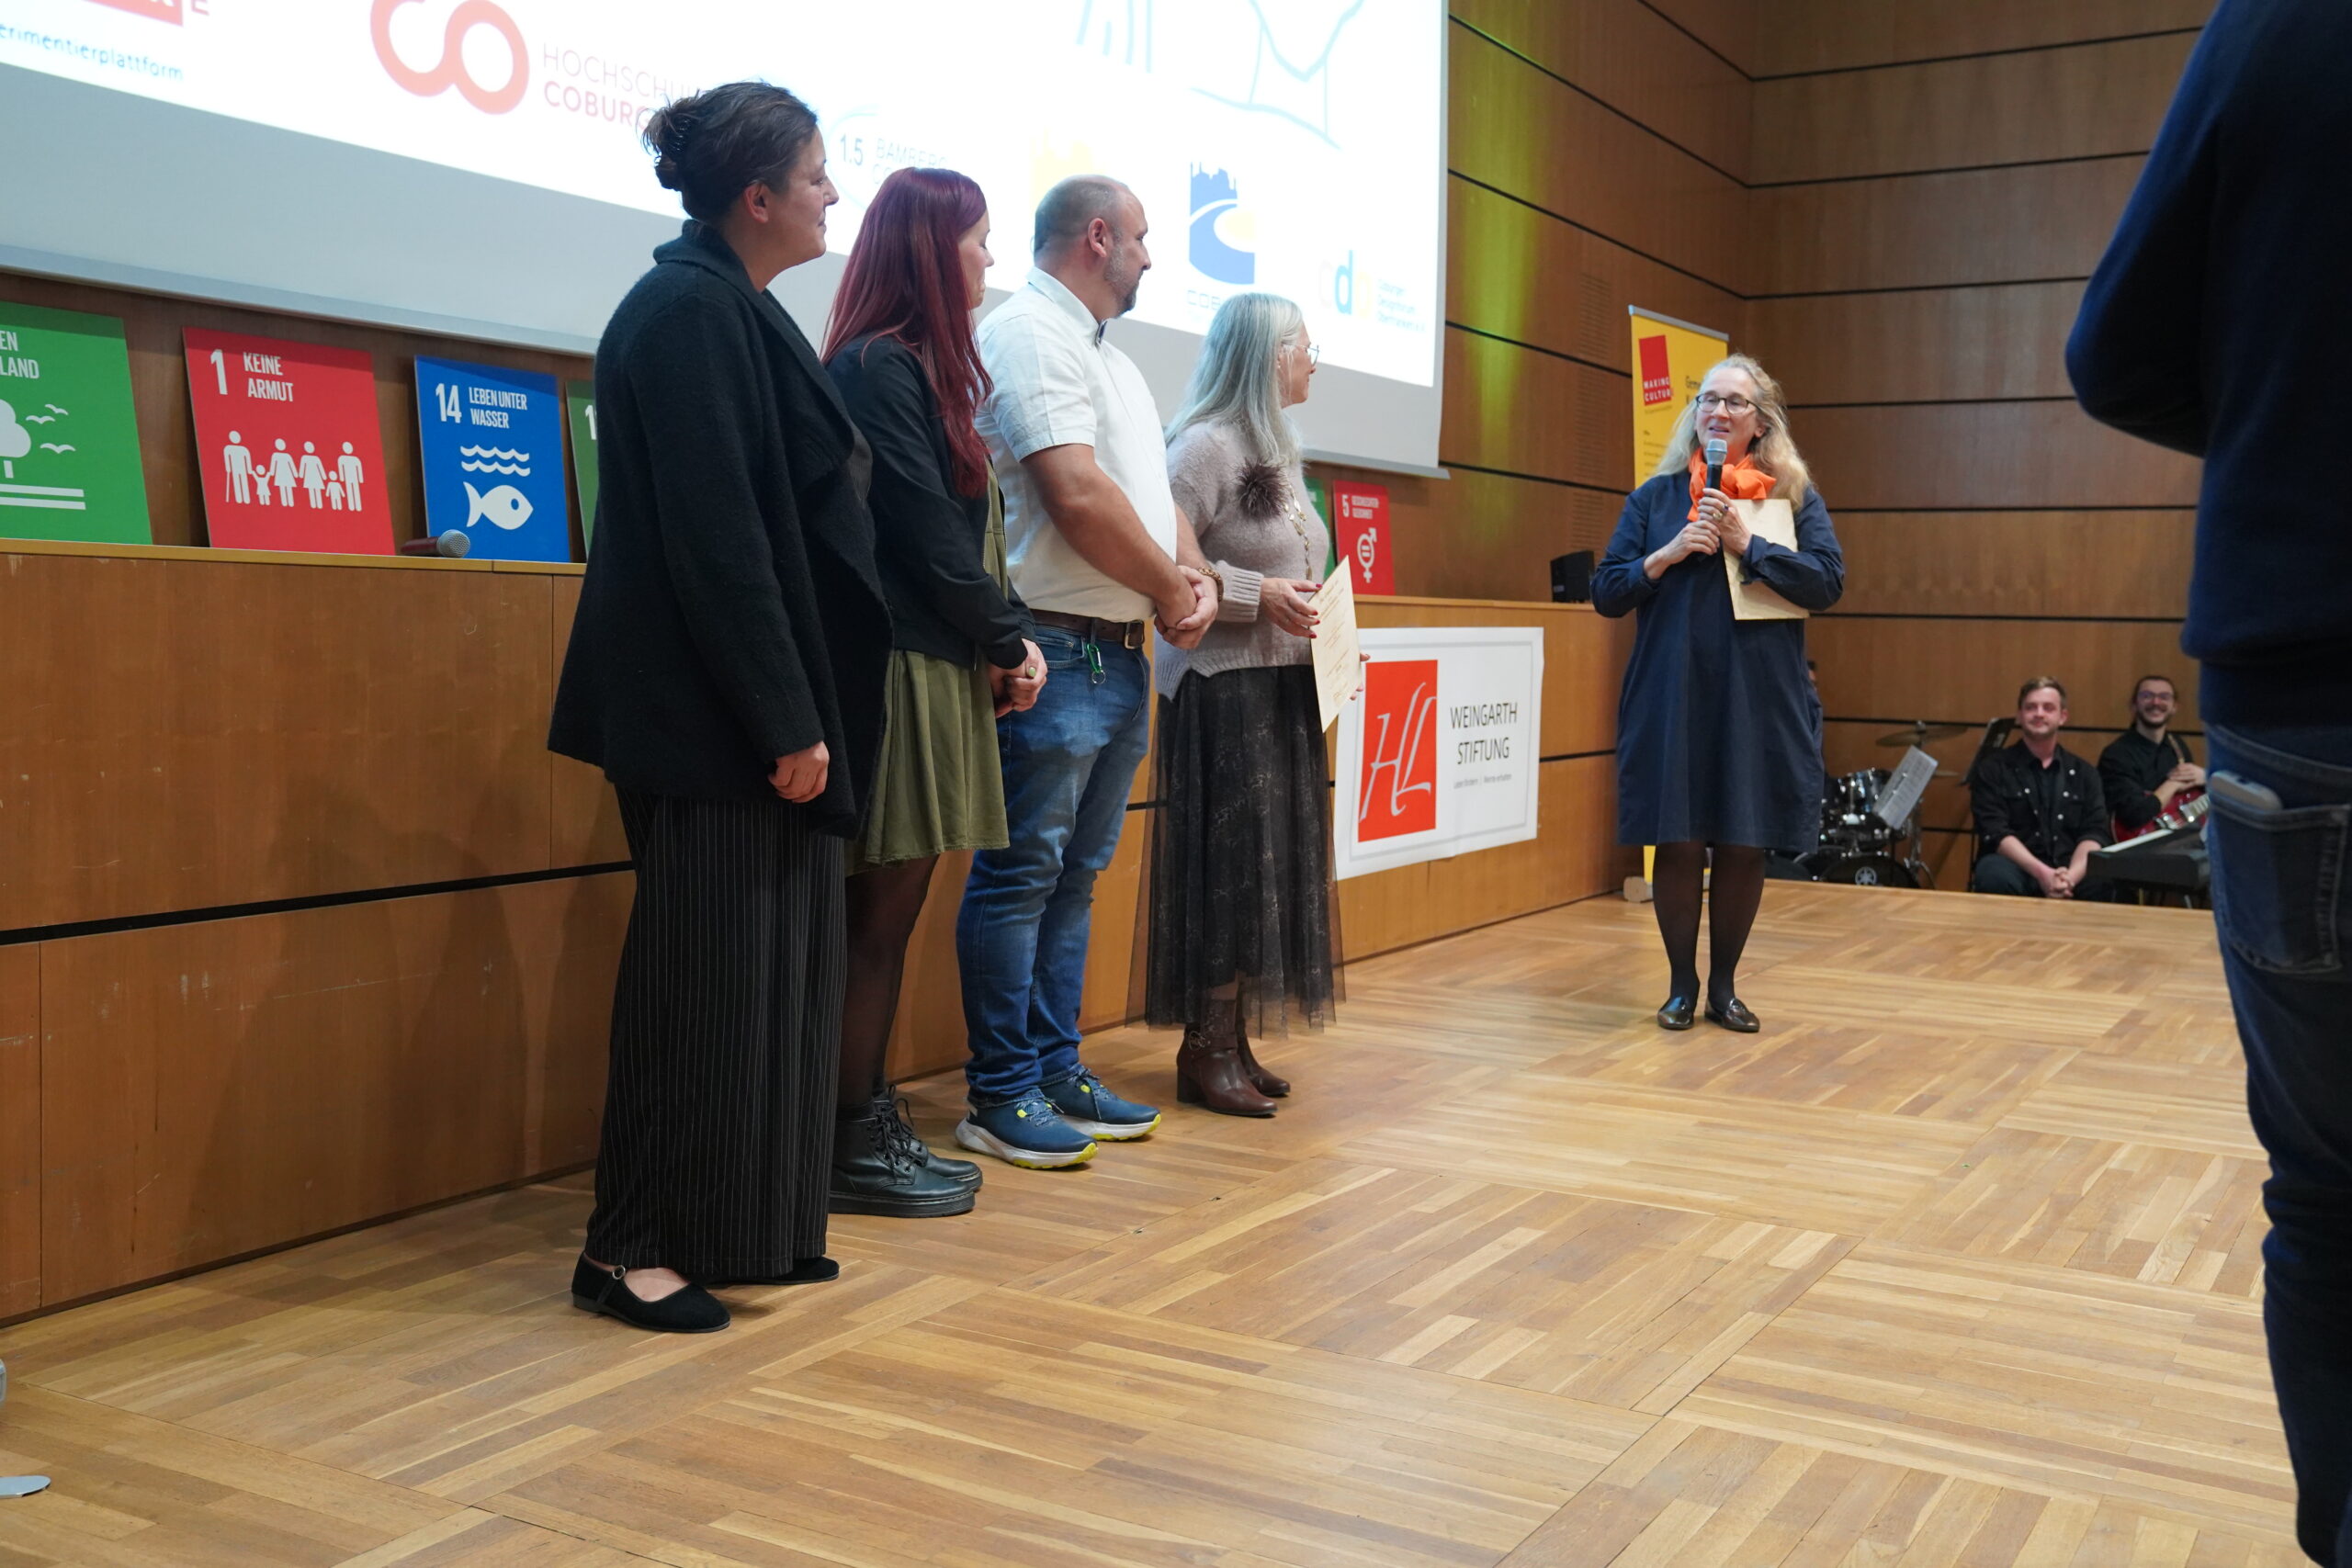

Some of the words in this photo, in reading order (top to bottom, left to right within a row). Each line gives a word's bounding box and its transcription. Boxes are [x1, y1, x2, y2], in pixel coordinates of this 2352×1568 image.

[209, 348, 228, 395] 1
[243, 352, 283, 376] KEINE
[247, 378, 294, 402] ARMUT
[435, 382, 462, 423] 14
[469, 386, 498, 407] LEBEN
[498, 391, 528, 412] UNTER
[469, 408, 510, 429] WASSER
[1341, 494, 1350, 518] 5
[1450, 702, 1518, 729] WEINGARTH
[1457, 737, 1510, 764] STIFTUNG
